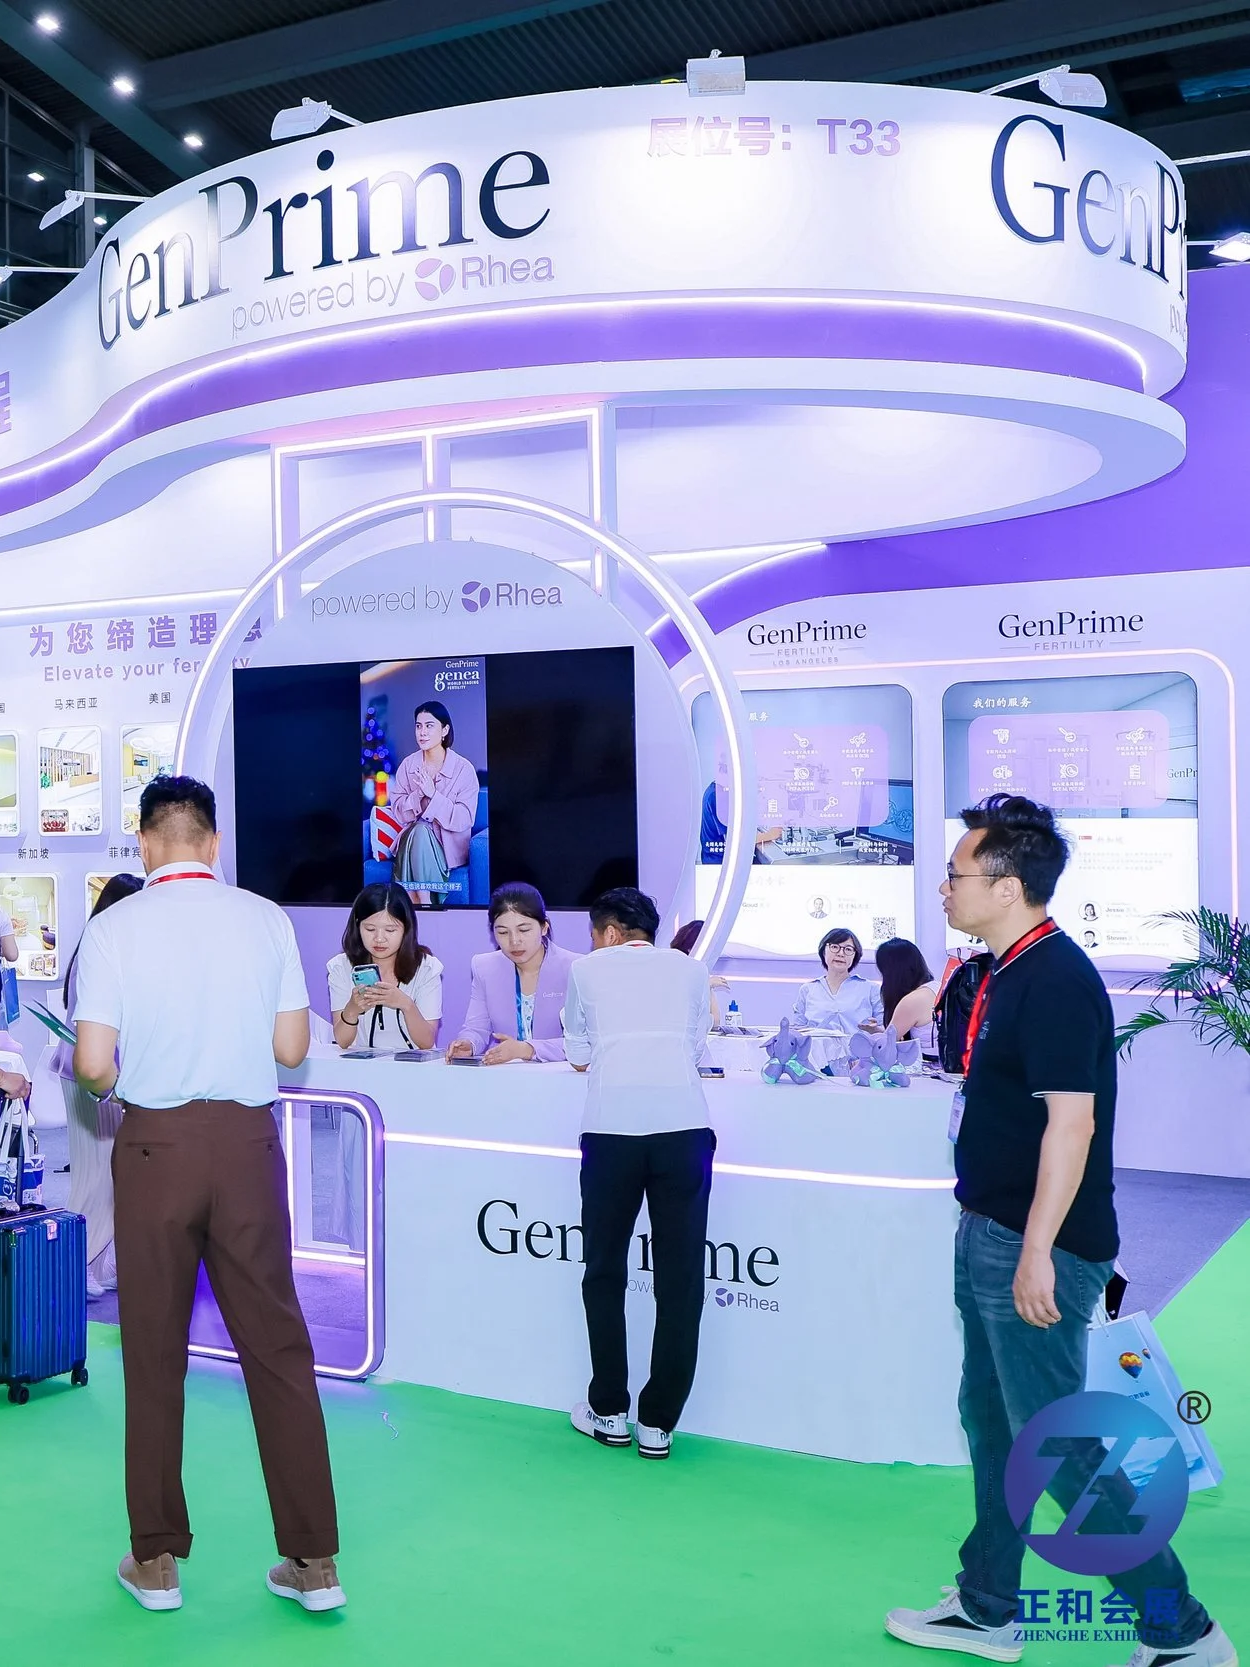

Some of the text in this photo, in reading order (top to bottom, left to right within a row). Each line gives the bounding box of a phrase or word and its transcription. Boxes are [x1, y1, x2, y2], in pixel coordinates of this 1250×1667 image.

[99, 149, 551, 351] GenPrime
[231, 253, 555, 340] powered by Rhea
[311, 581, 563, 621] powered by Rhea
[998, 610, 1144, 638] GenPrime
[747, 620, 867, 645] GenPrime
[777, 646, 834, 657] FERTILITY
[1034, 639, 1104, 651] FERTILITY
[445, 660, 479, 668] GenPrime
[795, 656, 839, 665] ANGELES
[44, 664, 114, 682] Elevate
[122, 662, 165, 681] your
[434, 670, 480, 691] genea
[54, 697, 98, 710] 马来西亚
[149, 692, 171, 704] 美国
[973, 696, 1032, 709] 我们的服务
[17, 848, 49, 859] 新加坡
[108, 846, 141, 858] 菲律宾
[476, 1199, 780, 1288] Genrme
[737, 1292, 780, 1313] Rhea
